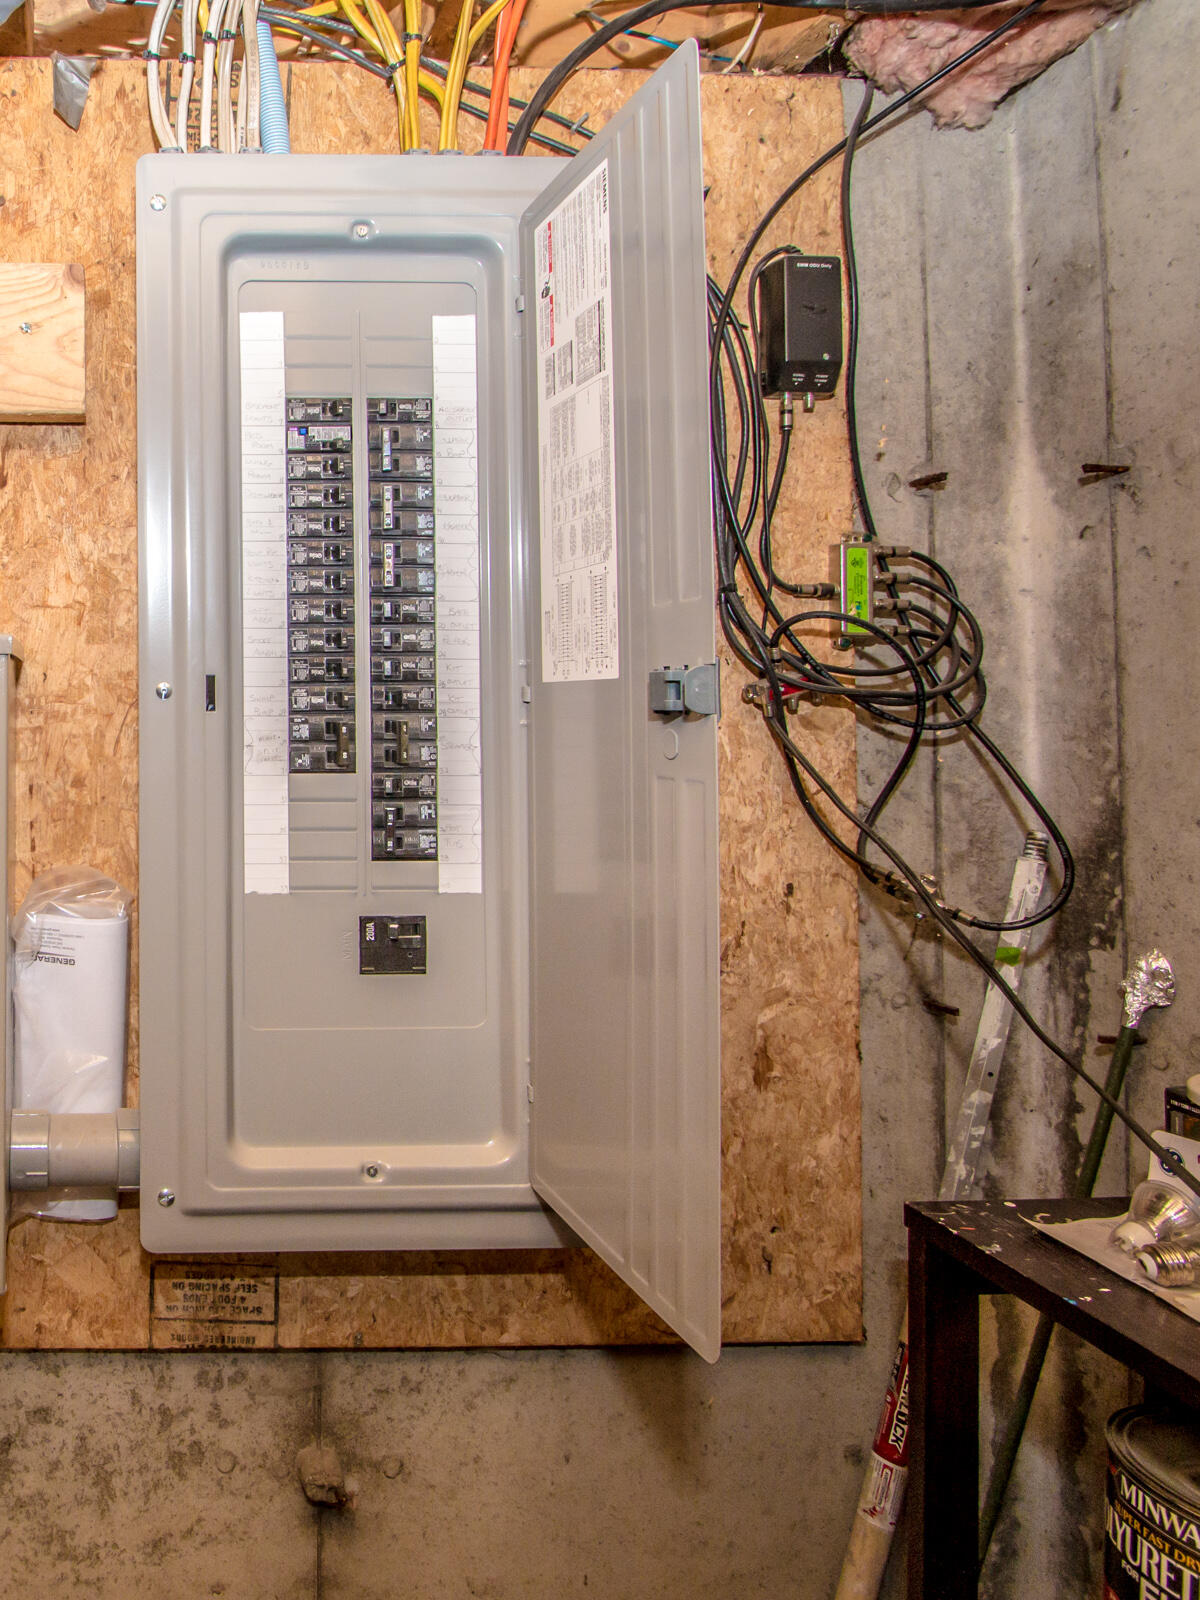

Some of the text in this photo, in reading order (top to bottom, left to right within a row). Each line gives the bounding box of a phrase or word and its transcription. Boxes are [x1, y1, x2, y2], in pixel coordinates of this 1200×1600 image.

[365, 922, 375, 941] 200A
[188, 1282, 231, 1292] SPACING
[1143, 1526, 1171, 1554] FAST
[1121, 1559, 1139, 1582] FOR
